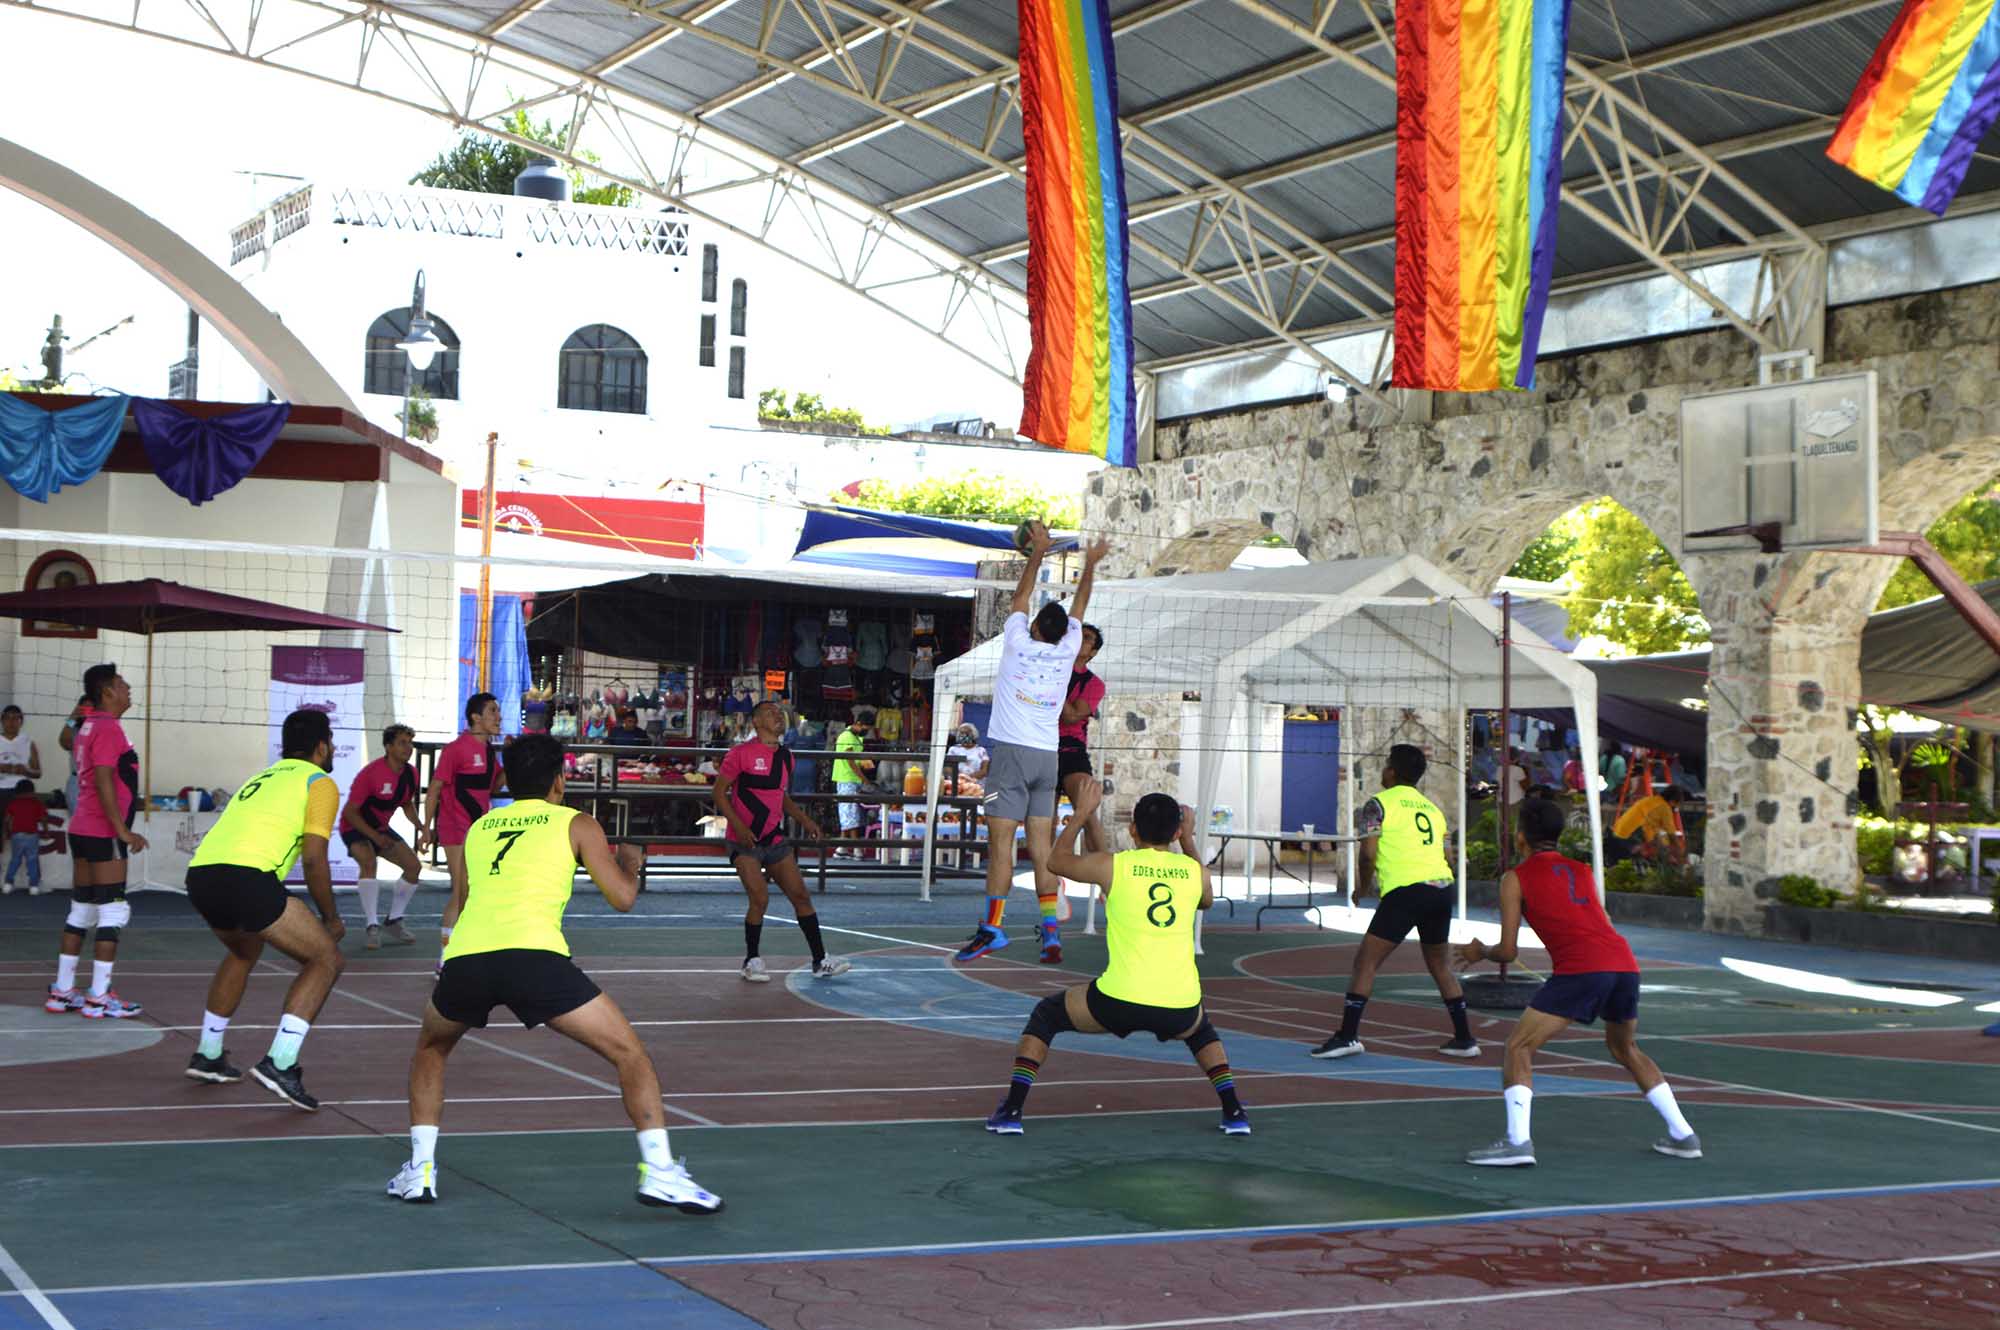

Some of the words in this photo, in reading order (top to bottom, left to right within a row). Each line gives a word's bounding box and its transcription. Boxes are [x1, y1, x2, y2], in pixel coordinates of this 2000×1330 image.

[238, 772, 275, 801] 6
[482, 817, 507, 830] EDER
[510, 814, 550, 828] CAMPOS
[1415, 812, 1433, 845] 9
[489, 830, 526, 876] 7
[1133, 865, 1154, 878] EDER
[1156, 868, 1189, 880] CAMPOS
[1552, 864, 1590, 905] 2
[1146, 882, 1176, 928] 8
